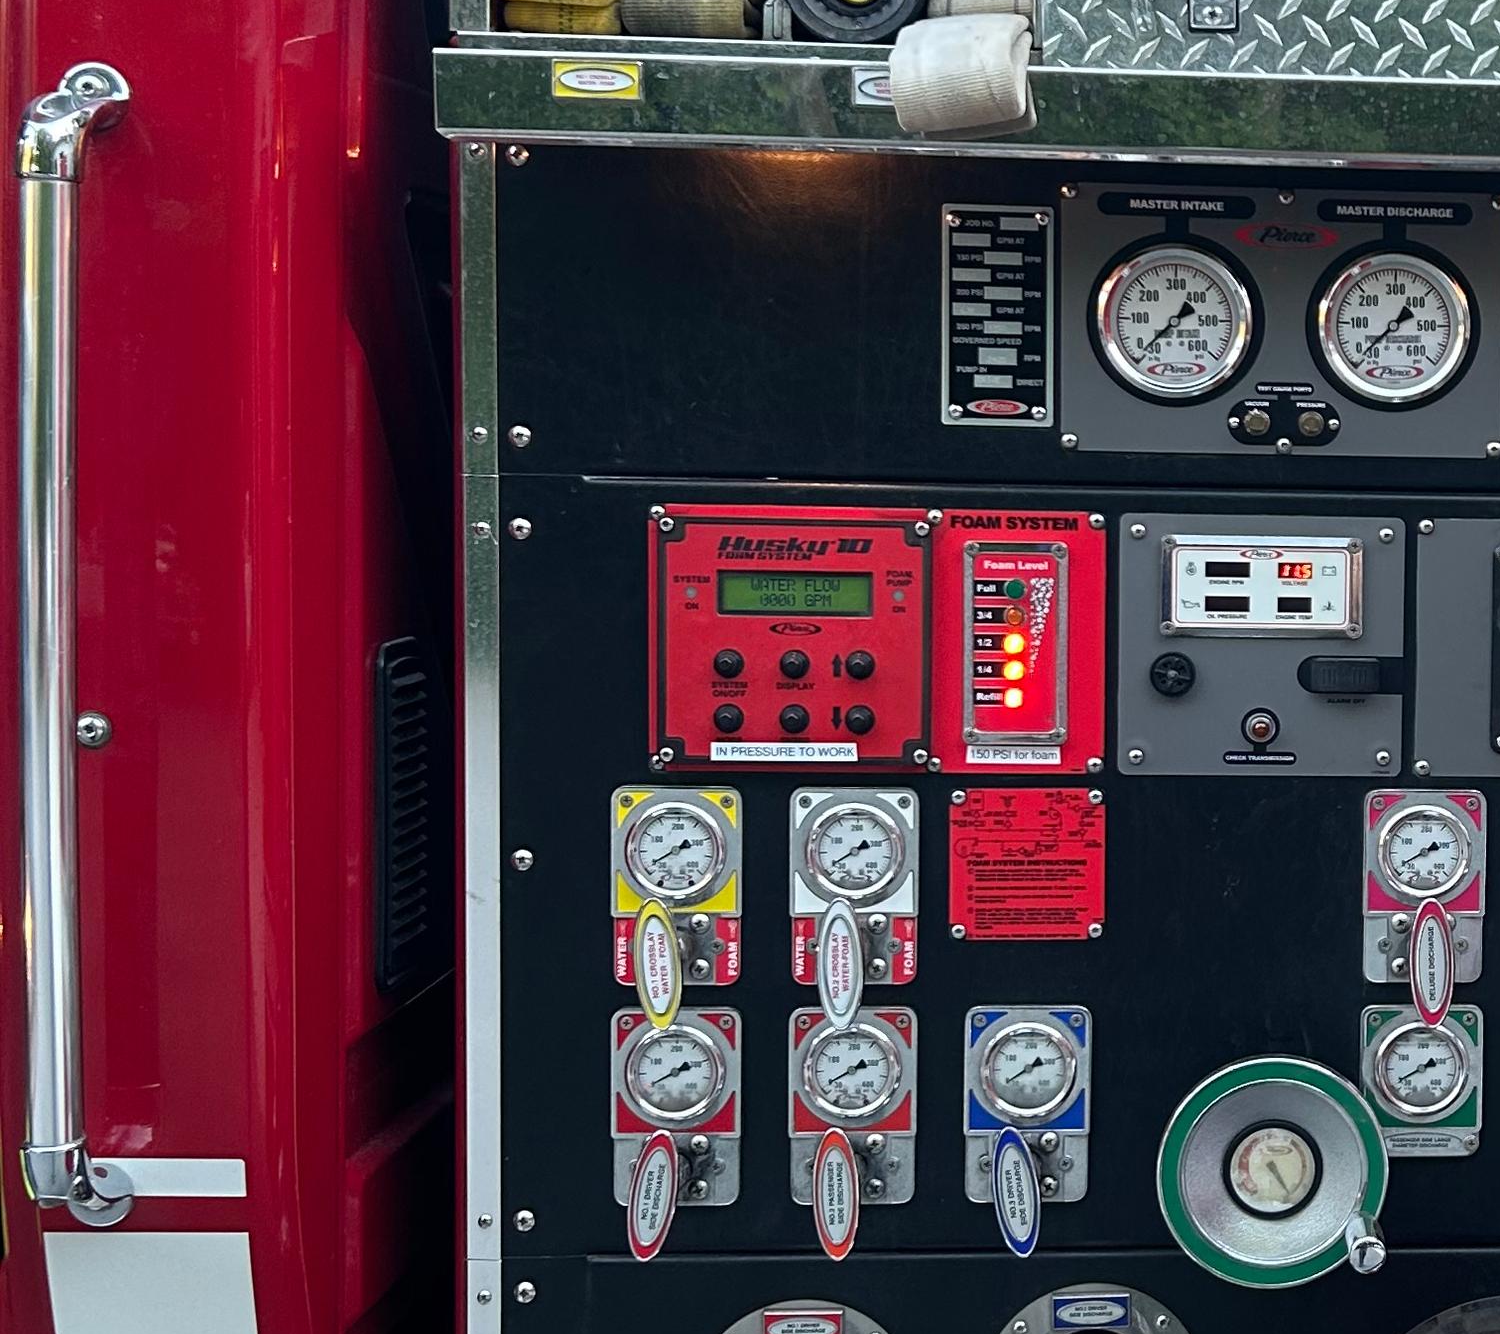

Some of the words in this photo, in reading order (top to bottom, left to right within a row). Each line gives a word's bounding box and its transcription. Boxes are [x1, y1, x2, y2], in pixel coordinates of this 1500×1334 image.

[1129, 198, 1179, 211] MASTER
[1181, 200, 1225, 212] INTAKE
[1336, 205, 1385, 217] MASTER
[1387, 206, 1454, 219] DISCHARGE
[1259, 225, 1317, 244] Pierce
[1166, 278, 1187, 291] 300
[1385, 283, 1406, 295] 300
[1139, 289, 1159, 302] 200
[1186, 291, 1207, 303] 400
[1359, 295, 1379, 307] 200
[1406, 296, 1425, 308] 400
[1131, 312, 1149, 323] 100
[1198, 314, 1218, 327] 500
[1350, 317, 1368, 328] 100
[1417, 320, 1437, 331] 500
[1188, 339, 1208, 352] 600
[1355, 342, 1362, 354] 0
[1406, 345, 1426, 357] 600
[1367, 347, 1379, 359] 30
[951, 515, 1002, 529] FOAM
[1006, 516, 1079, 531] SYSTEM
[717, 536, 830, 555] Husky
[837, 538, 873, 554] 10
[717, 552, 755, 560] FOAM
[759, 552, 812, 561] SYSTEM
[983, 560, 1016, 570] Foam
[1018, 560, 1049, 570] Level
[673, 575, 711, 584] SYSTEM
[886, 570, 913, 578] FOAM
[751, 578, 796, 592] WATER
[804, 579, 841, 592] FLOW
[886, 579, 912, 587] PUMP
[976, 584, 996, 593] Full
[685, 602, 699, 610] ON
[804, 593, 832, 607] GPM
[892, 605, 906, 613] ON
[976, 611, 993, 620] 3/4
[977, 638, 993, 647] 1/2
[977, 665, 993, 674] 1/4
[711, 681, 748, 689] SYSTEM
[776, 682, 816, 690] DISPLAY
[712, 690, 746, 698] ON/OFF
[715, 747, 728, 756] IN
[731, 746, 796, 757] PRESSURE
[799, 746, 816, 757] TO
[818, 746, 855, 757] WORK
[971, 749, 992, 760] 150
[993, 749, 1012, 759] PSI
[1014, 749, 1029, 759] for
[1031, 749, 1058, 760] foam
[658, 933, 667, 959] FOAM
[1427, 926, 1435, 971] DISCHARGE
[617, 936, 628, 976] WATER
[647, 931, 659, 979] CROSSLAY
[728, 941, 738, 976] FOAM
[795, 936, 805, 976] WATER
[831, 932, 840, 979] CROSSLAY
[903, 941, 914, 976] FOAM
[660, 967, 670, 996] WATER
[1429, 971, 1437, 1001] DELUGE
[643, 1170, 656, 1200] DRIVER
[651, 1163, 667, 1210] DISCHARGE
[826, 1161, 835, 1206] PASSENGER
[836, 1162, 844, 1205] DISCHARGE
[1005, 1169, 1014, 1199] DRIVER
[1013, 1159, 1026, 1207] DISCHARGE
